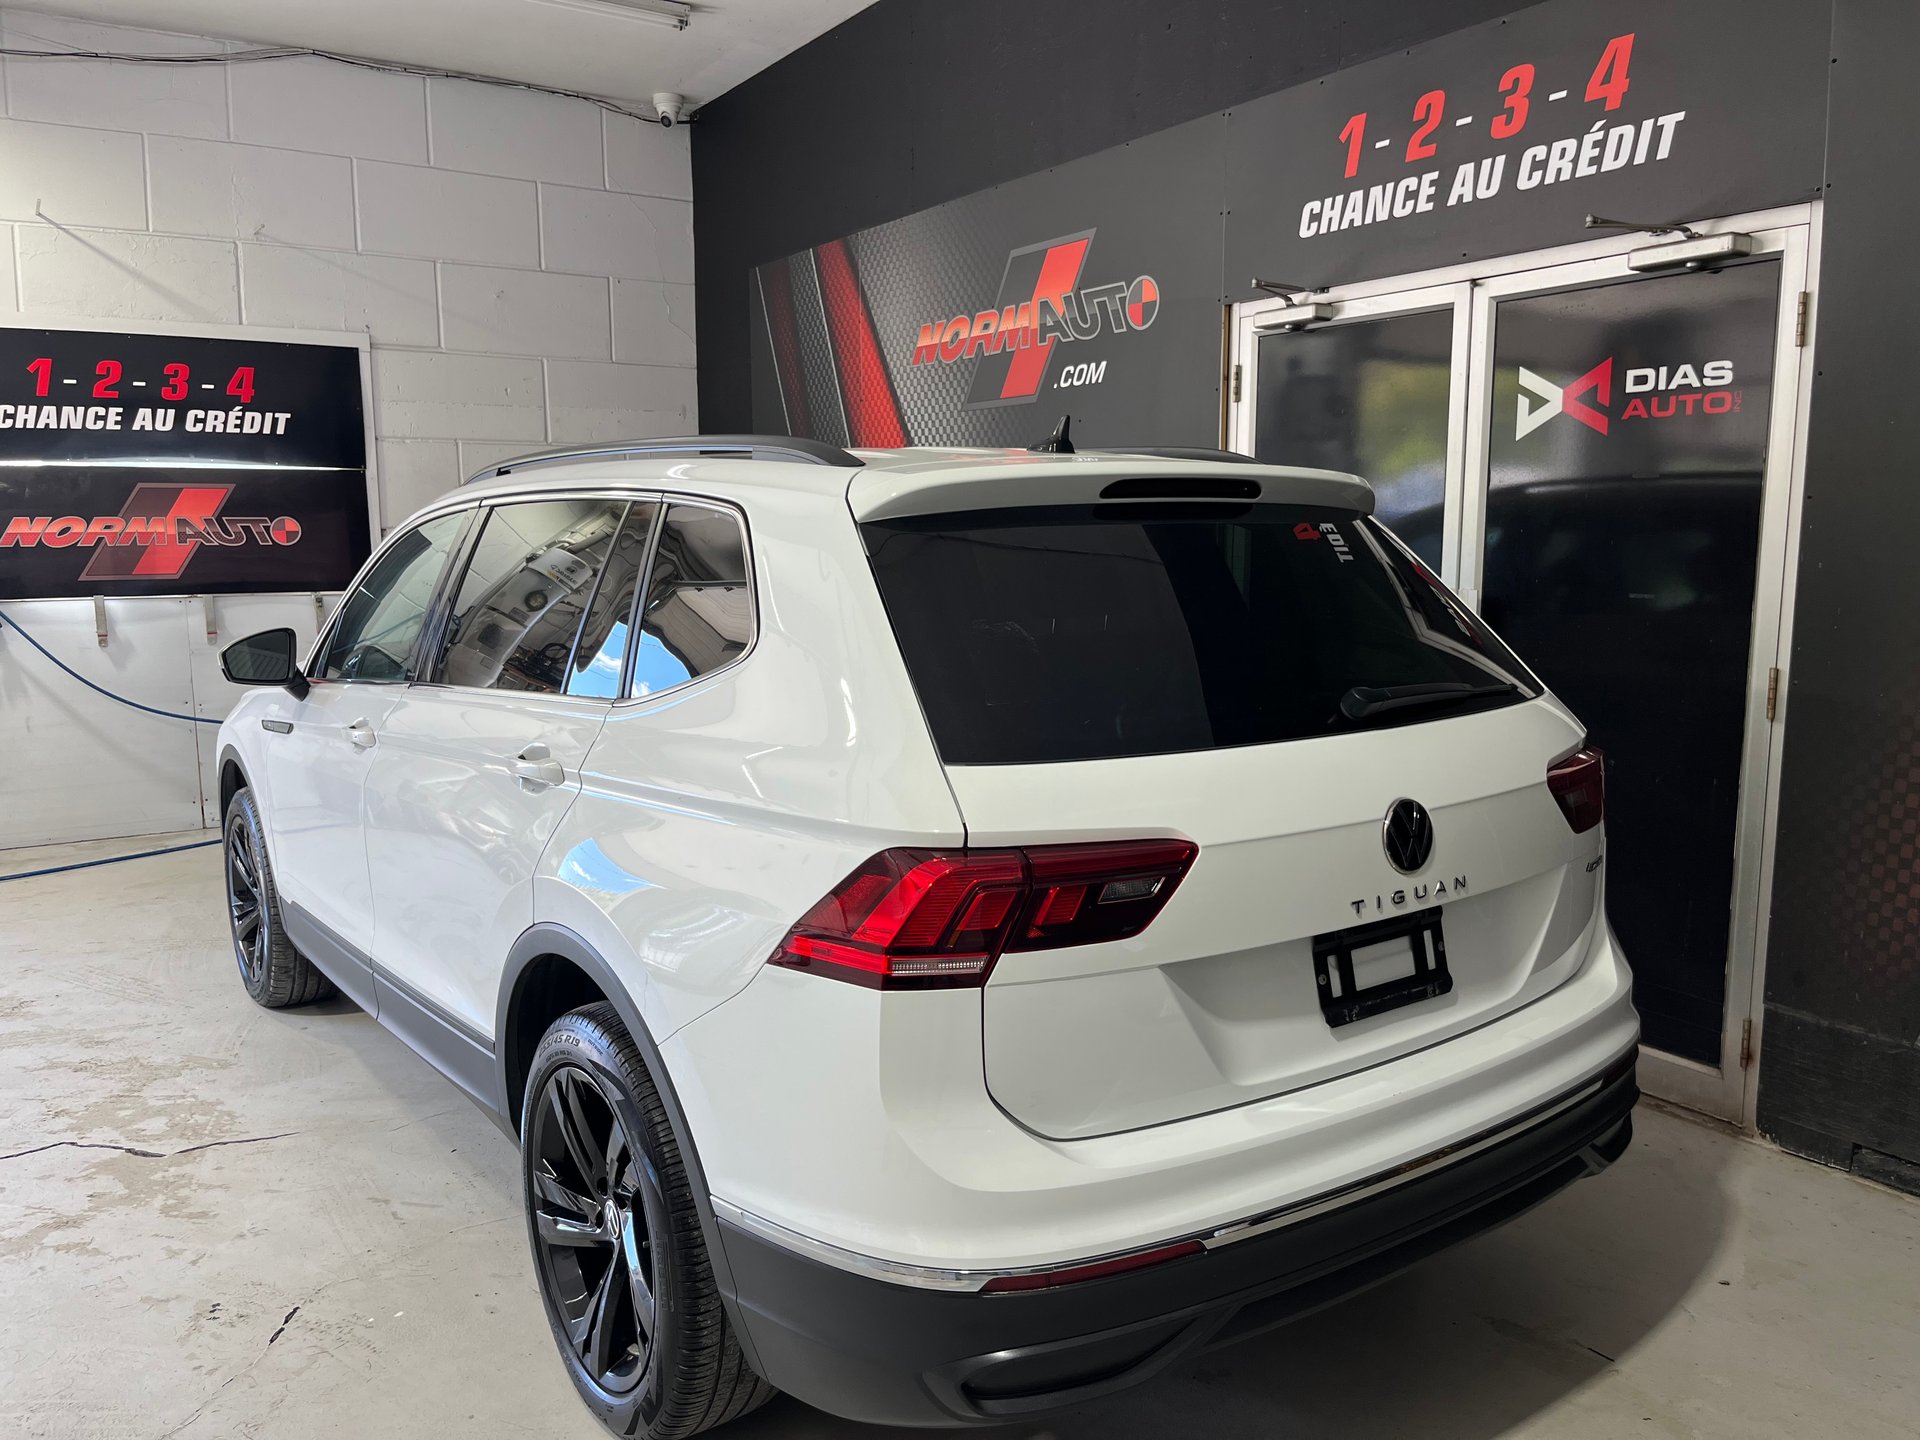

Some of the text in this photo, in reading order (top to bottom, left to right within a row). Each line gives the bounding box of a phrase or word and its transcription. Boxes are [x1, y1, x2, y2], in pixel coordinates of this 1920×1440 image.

[1298, 110, 1687, 239] CHANCE AU CRÉDIT
[1053, 361, 1108, 389] .COM
[1624, 359, 1734, 394] DIAS
[0, 404, 291, 435] CHANCE AU CRÉDIT
[1620, 390, 1733, 421] AUTO
[1351, 874, 1468, 915] TIGUAN
